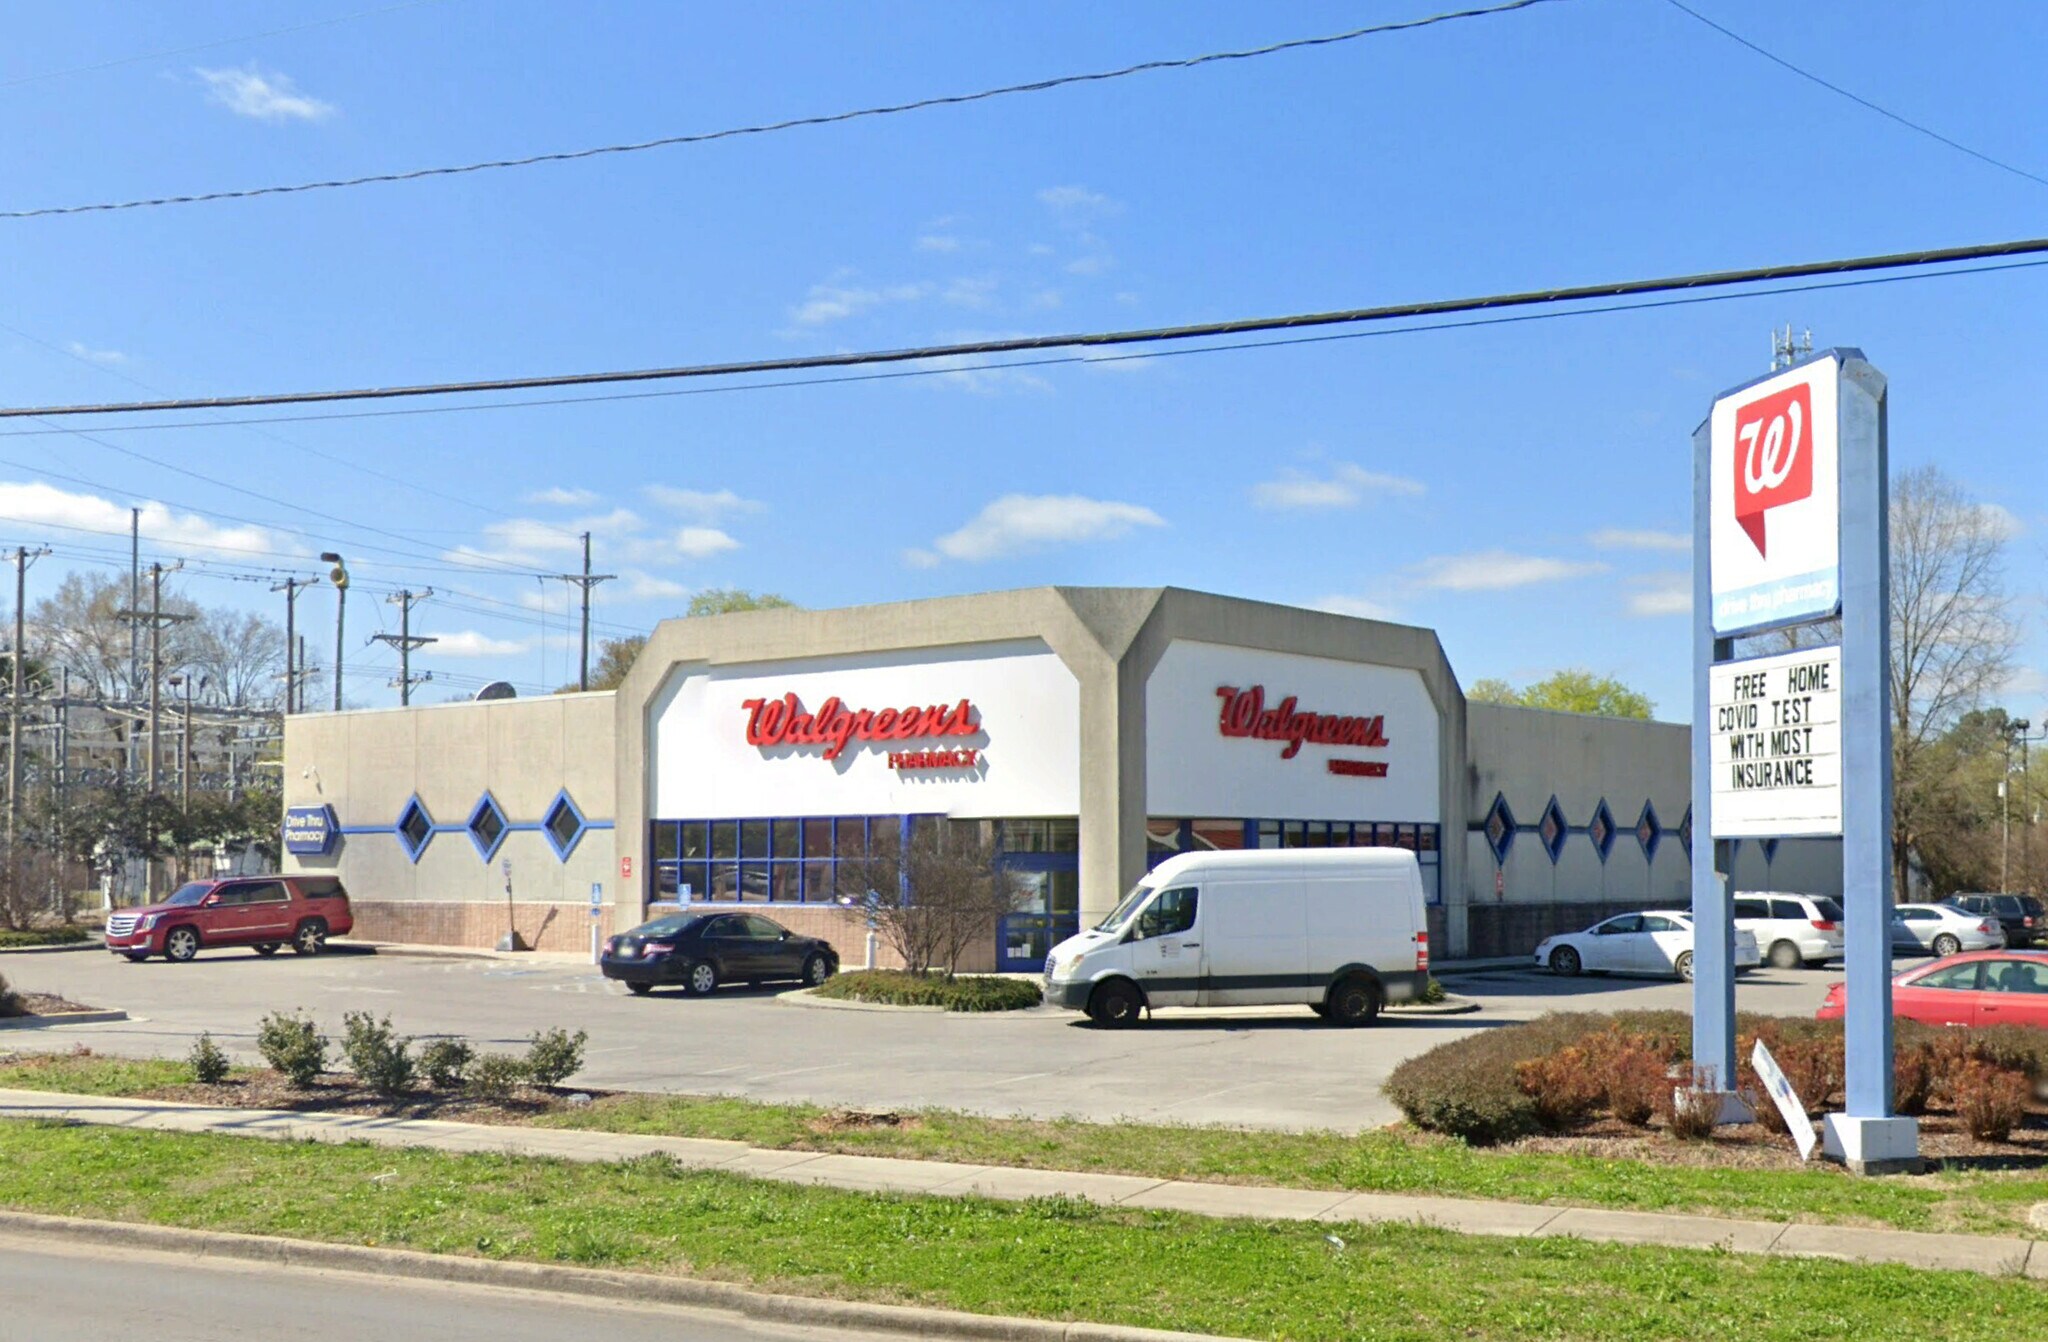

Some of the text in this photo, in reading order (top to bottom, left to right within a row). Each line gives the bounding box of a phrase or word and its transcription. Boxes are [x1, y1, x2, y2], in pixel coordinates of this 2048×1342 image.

[1739, 400, 1802, 494] W
[1734, 663, 1830, 700] FREE HOME
[741, 692, 981, 761] Walgreens
[1215, 684, 1390, 760] Walgreens
[1718, 696, 1812, 731] COVID TEST
[888, 749, 979, 770] PHARMACY
[1730, 728, 1813, 760] WITH MOST
[1732, 759, 1813, 789] INSURANCE
[285, 829, 325, 843] Pharmacy
[286, 814, 323, 828] Drive Thru
